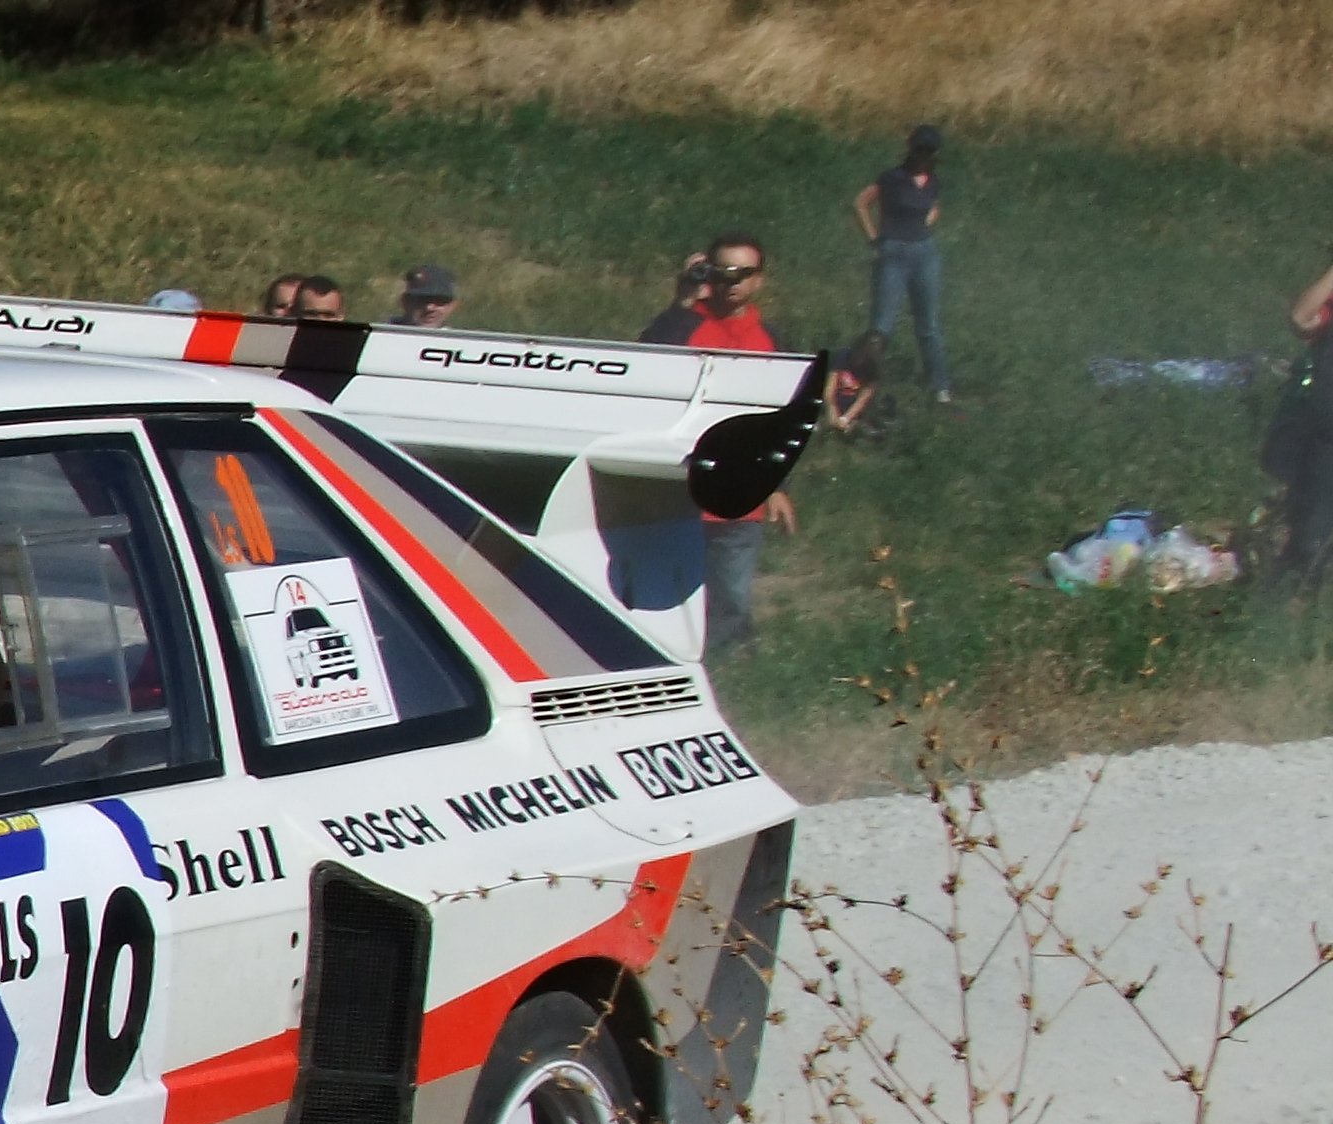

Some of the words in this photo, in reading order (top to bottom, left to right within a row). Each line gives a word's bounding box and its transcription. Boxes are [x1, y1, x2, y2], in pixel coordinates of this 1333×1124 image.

[419, 347, 629, 376] quattro
[445, 763, 620, 835] MICHELIN
[619, 732, 760, 799] BOGE
[320, 804, 446, 859] BOSCH
[46, 885, 156, 1107] 10
